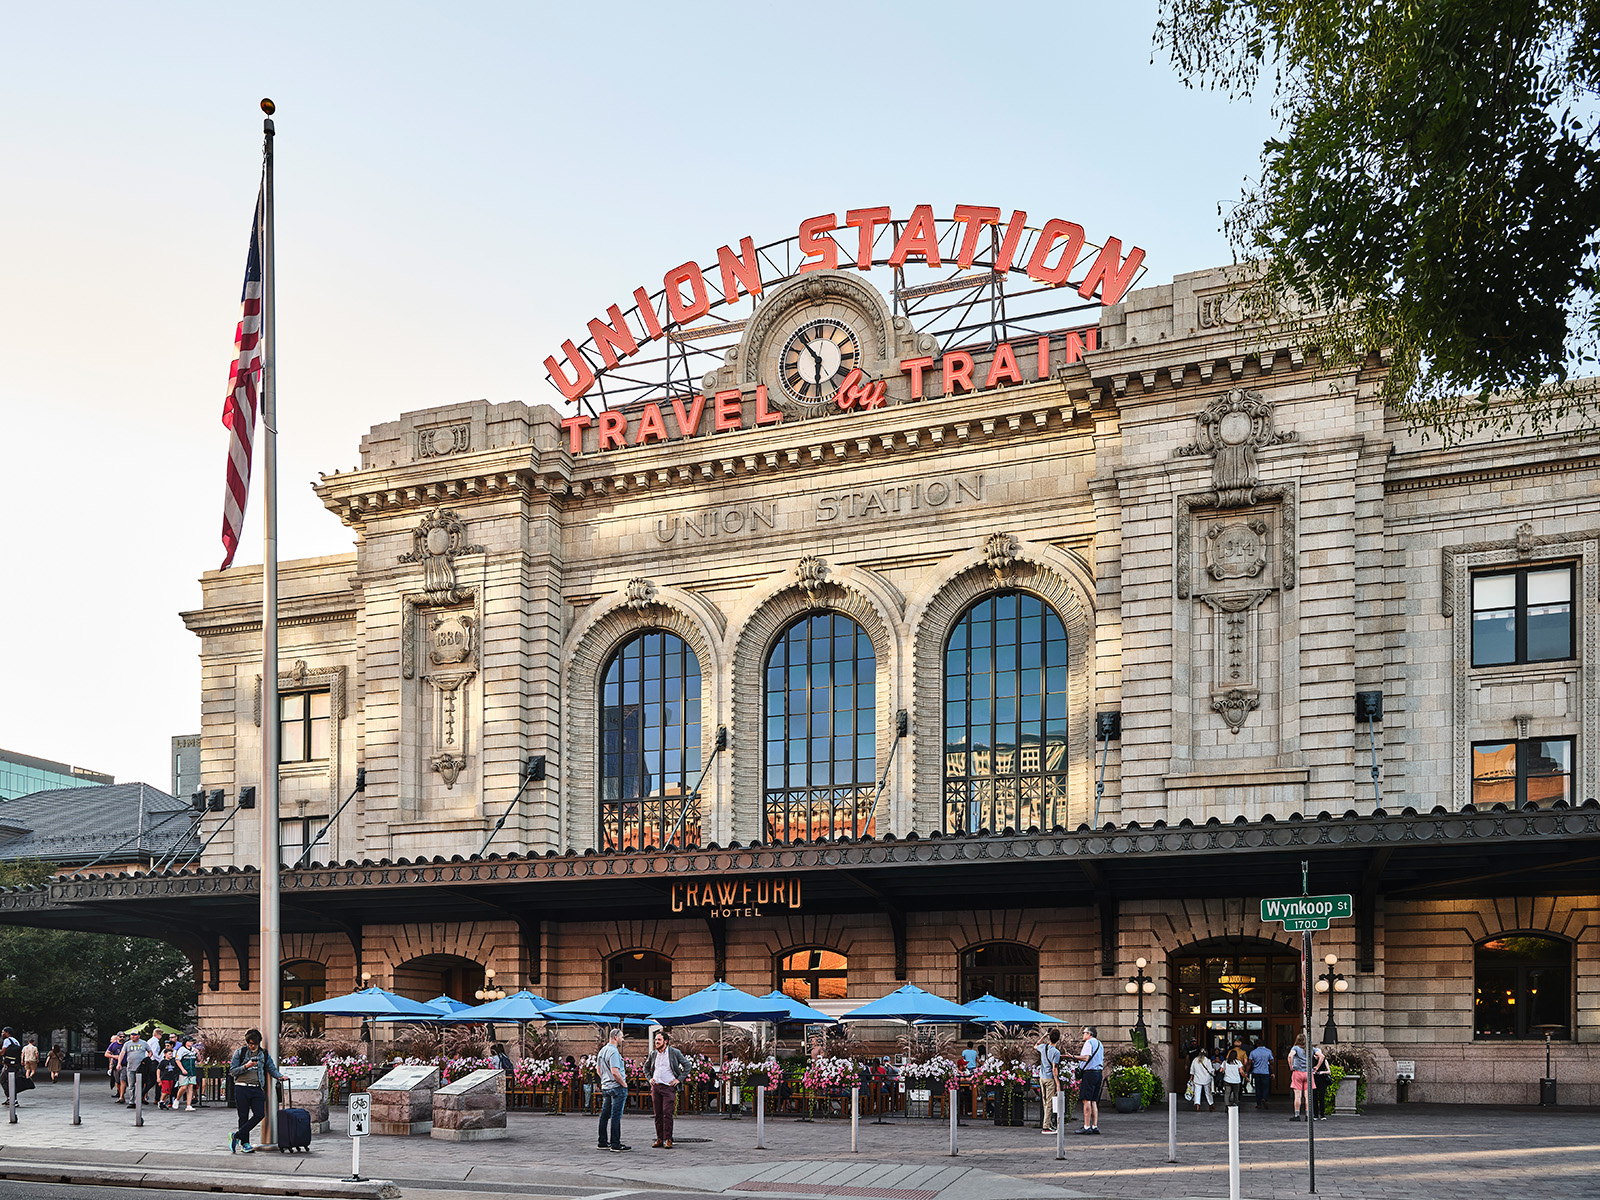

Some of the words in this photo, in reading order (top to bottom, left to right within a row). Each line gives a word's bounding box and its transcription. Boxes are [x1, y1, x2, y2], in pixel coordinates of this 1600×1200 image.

[543, 236, 762, 401] UNION
[799, 204, 1146, 306] STATION
[561, 384, 784, 454] TRAVEL
[832, 368, 888, 411] by
[900, 328, 1097, 400] TRAIN
[655, 500, 777, 543] UNION
[816, 474, 983, 522] STATION
[435, 631, 464, 647] 1880
[671, 877, 801, 912] CRAWFORD
[710, 907, 762, 918] HOTEL
[1266, 900, 1333, 917] Wynkoop
[1337, 901, 1348, 910] St
[1294, 920, 1318, 929] 1700
[351, 1112, 368, 1122] ONLY
